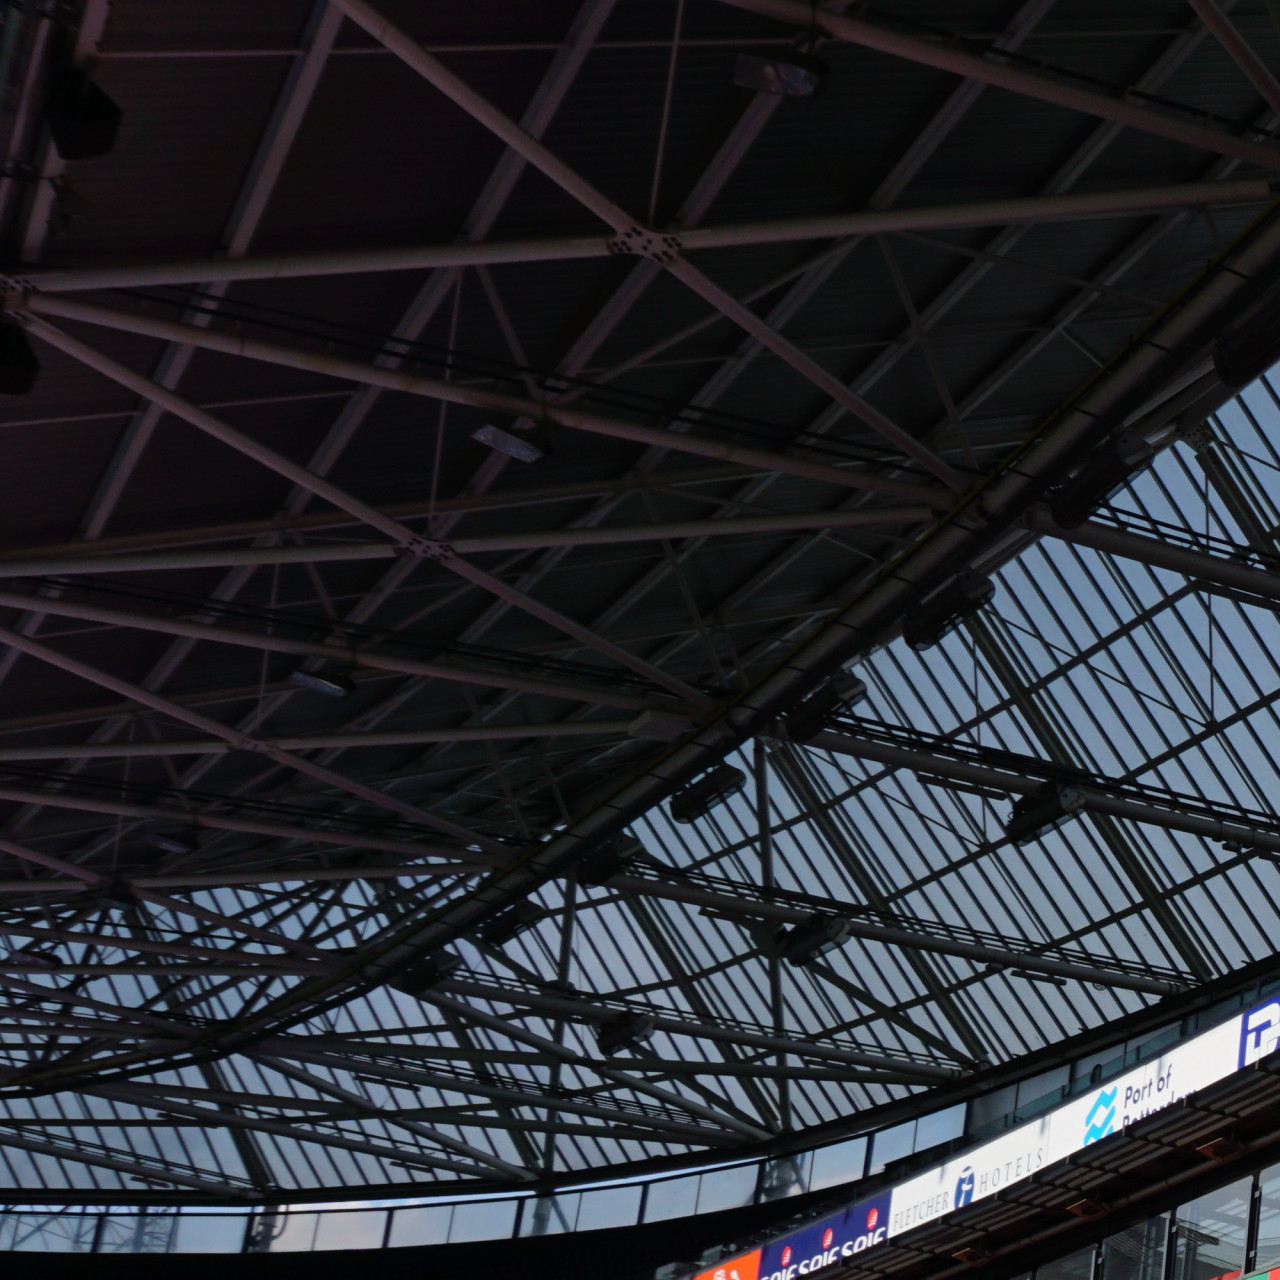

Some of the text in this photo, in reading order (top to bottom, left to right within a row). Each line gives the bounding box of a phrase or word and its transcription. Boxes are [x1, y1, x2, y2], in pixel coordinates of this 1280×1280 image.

[1124, 1078, 1153, 1109] Port
[1156, 1063, 1173, 1092] of
[893, 1147, 1044, 1232] FLETCHER HOTELS
